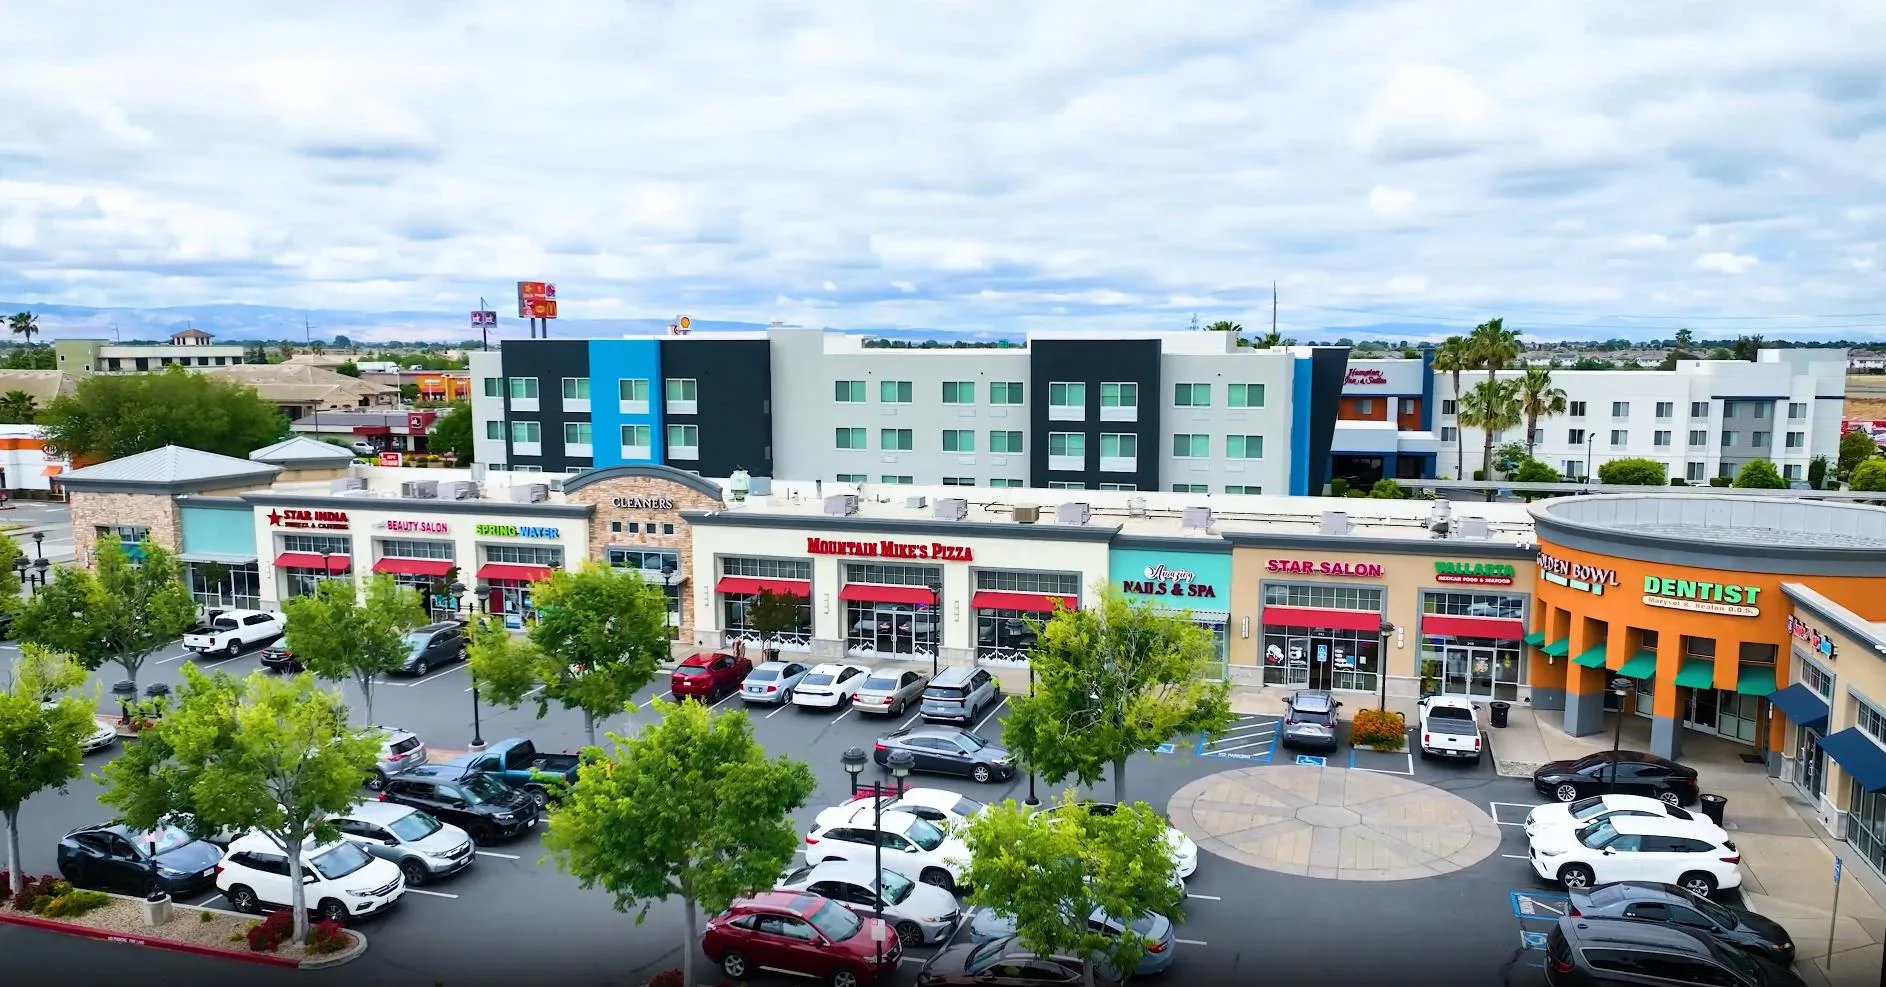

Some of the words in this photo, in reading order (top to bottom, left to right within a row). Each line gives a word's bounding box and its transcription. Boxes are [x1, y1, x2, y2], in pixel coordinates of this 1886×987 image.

[612, 497, 674, 509] CLEANERS
[284, 510, 312, 520] STAR
[315, 511, 349, 522] INDIA
[387, 520, 418, 531] BEAUTY
[421, 522, 448, 533] SALON
[475, 524, 517, 537] SPRING
[519, 527, 560, 539] WATER
[1145, 564, 1194, 583] Amazing
[1267, 560, 1314, 573] STAR
[1320, 562, 1381, 576] SALON
[1435, 561, 1515, 577] VALLARTA
[1536, 552, 1571, 575] GOLDEN
[1573, 563, 1621, 586] BOWL
[1123, 581, 1167, 595] NAILS
[1170, 583, 1184, 596] &
[1187, 584, 1216, 598] SPA
[1643, 575, 1761, 605] DENTIST
